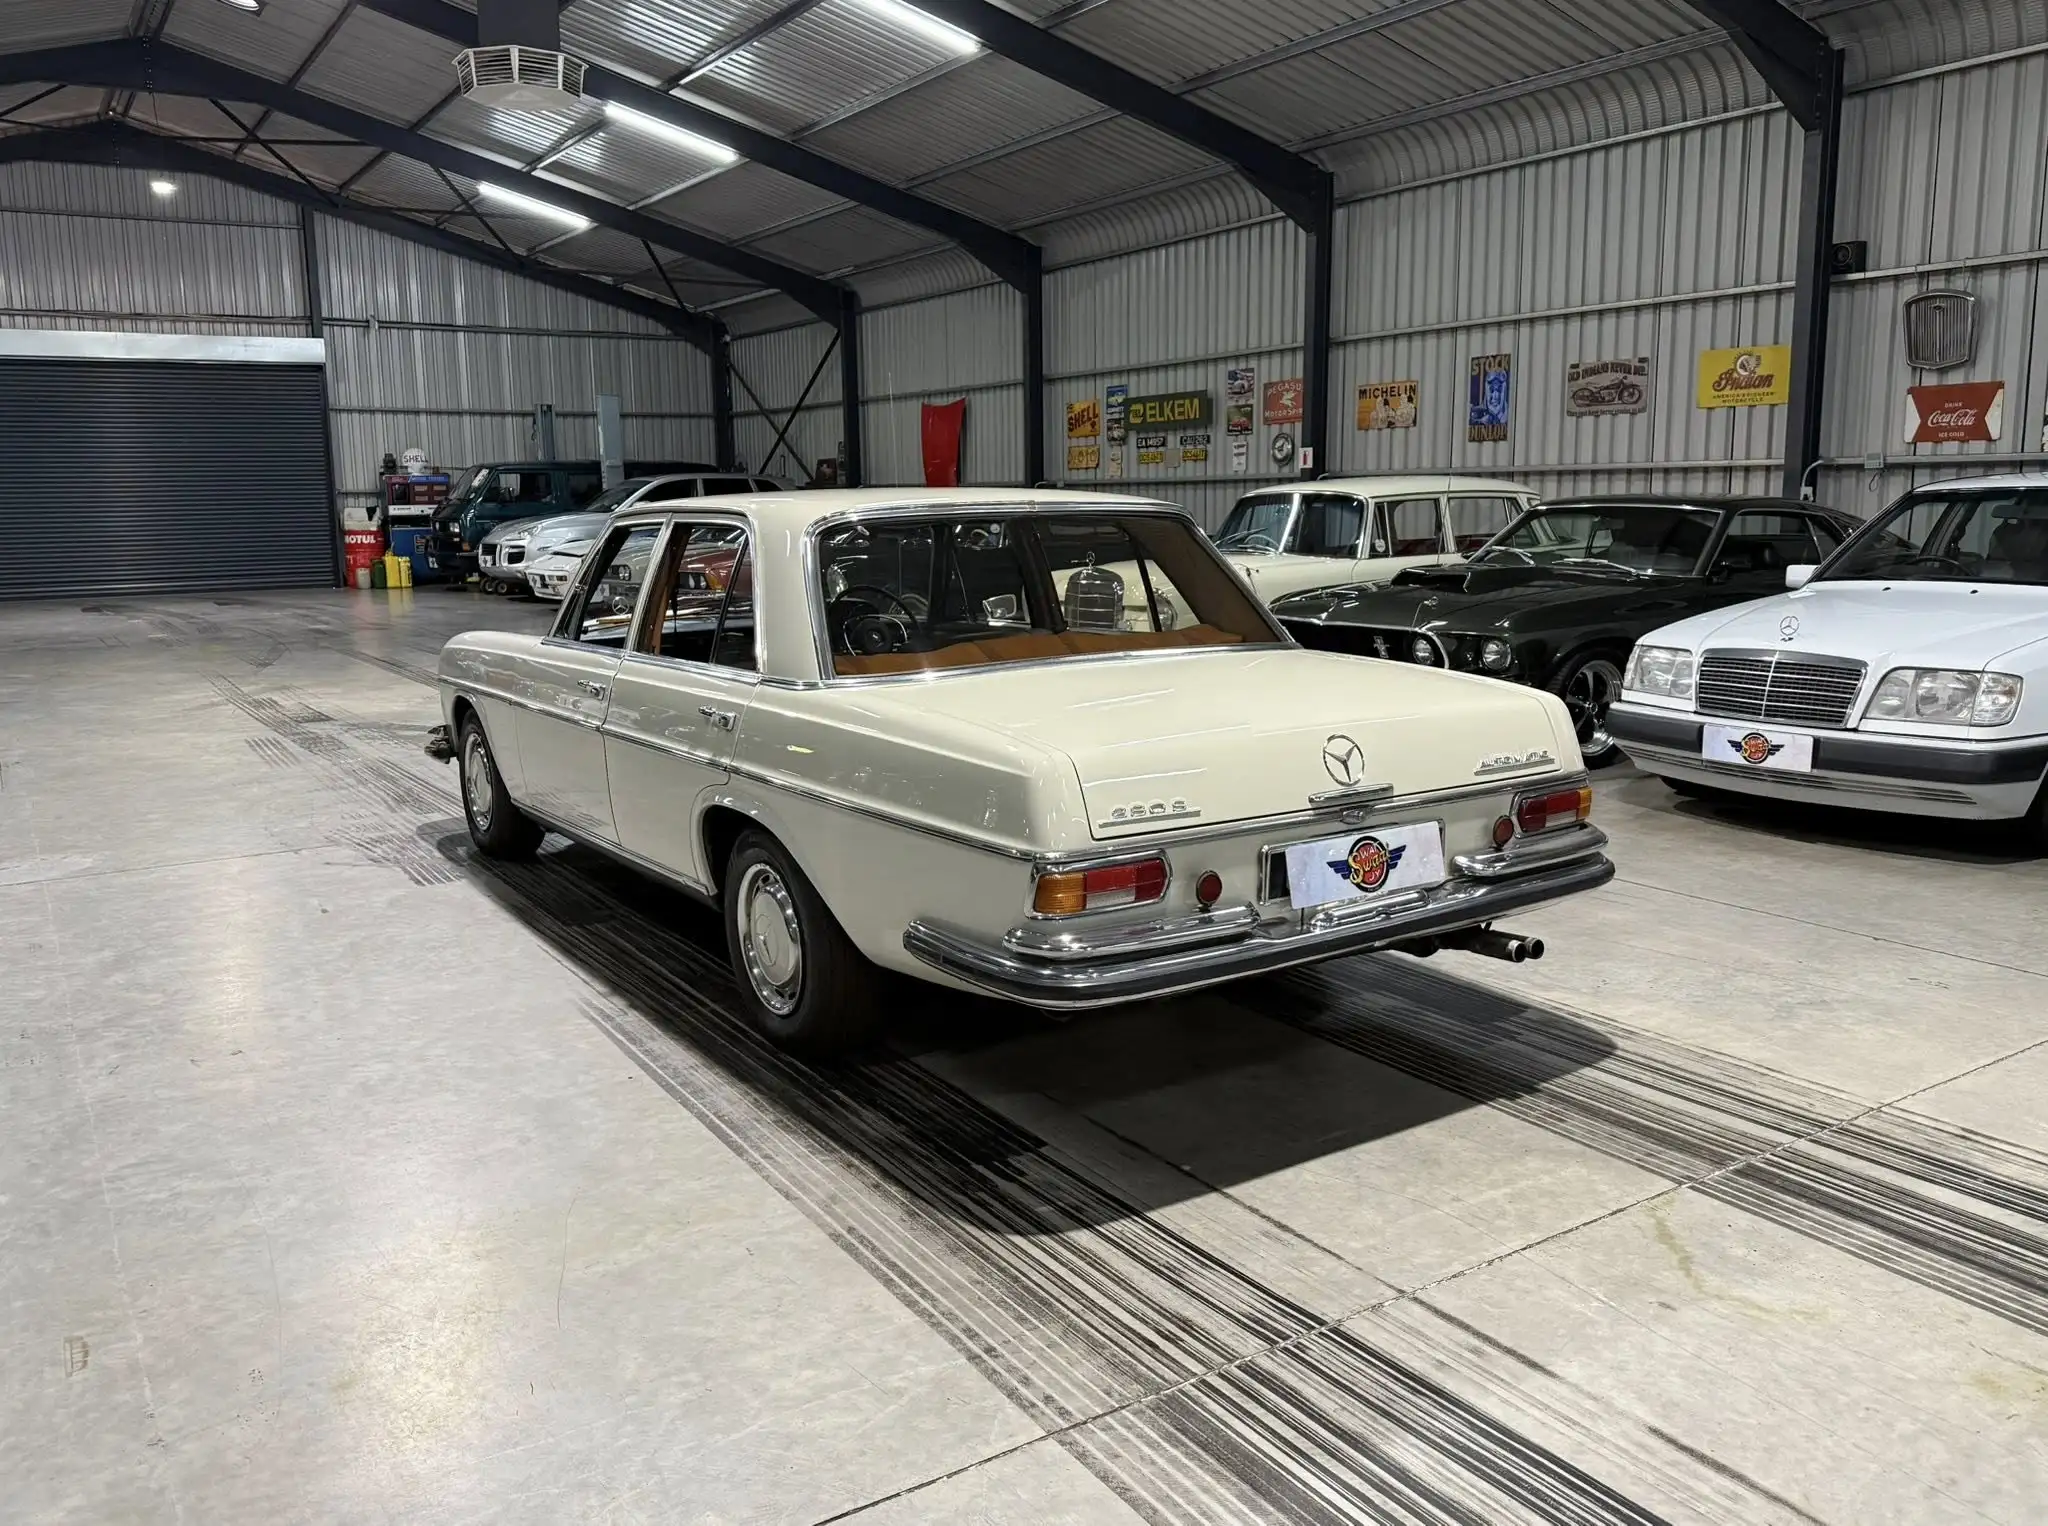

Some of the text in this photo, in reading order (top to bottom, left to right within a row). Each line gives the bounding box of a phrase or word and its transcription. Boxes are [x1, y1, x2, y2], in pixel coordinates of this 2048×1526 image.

[1712, 368, 1774, 392] Indian
[1267, 382, 1303, 398] PEGASU
[1358, 384, 1417, 400] MICHELIN
[1068, 402, 1099, 432] SHELL
[1146, 398, 1200, 423] ELKEM
[1927, 408, 1978, 427] Coca-Cola
[1468, 425, 1507, 442] DUNLOP
[403, 454, 429, 463] SHELL
